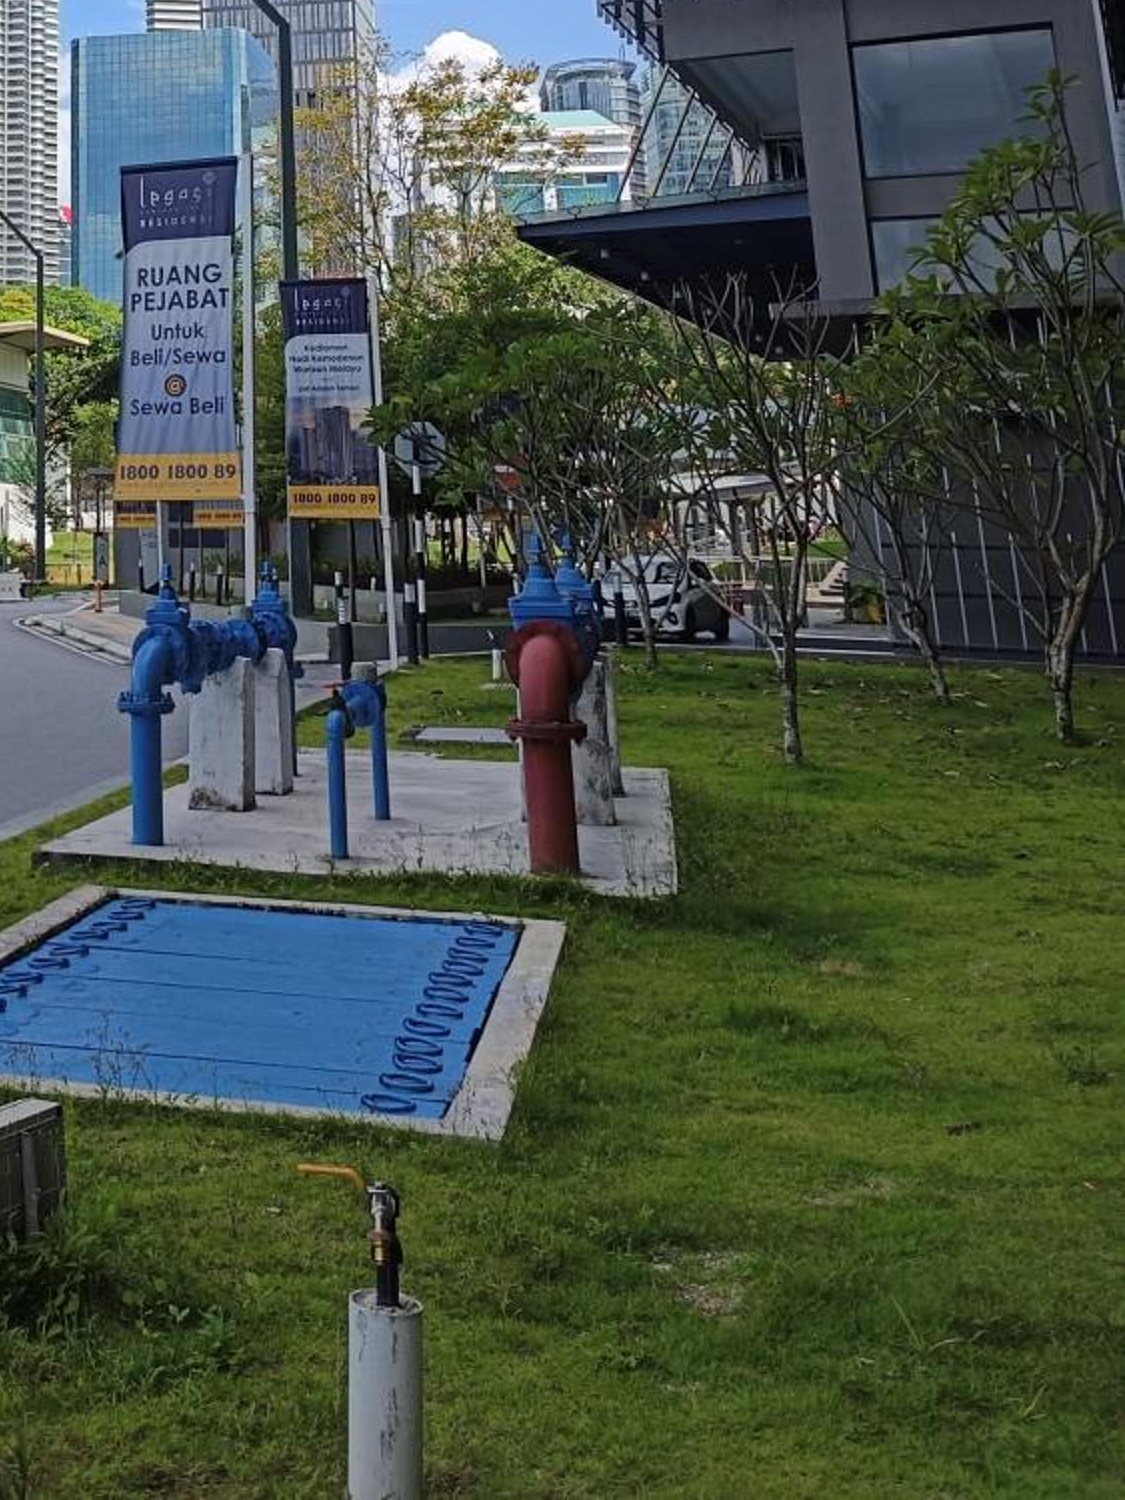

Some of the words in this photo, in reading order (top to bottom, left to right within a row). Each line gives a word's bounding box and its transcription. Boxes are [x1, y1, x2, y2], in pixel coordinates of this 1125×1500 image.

[137, 263, 222, 288] RUANG
[130, 287, 230, 313] PEJABAT
[151, 321, 204, 341] Untuk
[130, 347, 226, 367] Beli/Sewa
[130, 399, 182, 416] Sewa
[189, 396, 225, 415] Beli
[120, 464, 160, 481] 1800
[167, 464, 208, 480] 1800
[214, 463, 236, 479] 89
[293, 492, 322, 504] 1800
[328, 492, 356, 504] 1800
[360, 492, 376, 505] 89
